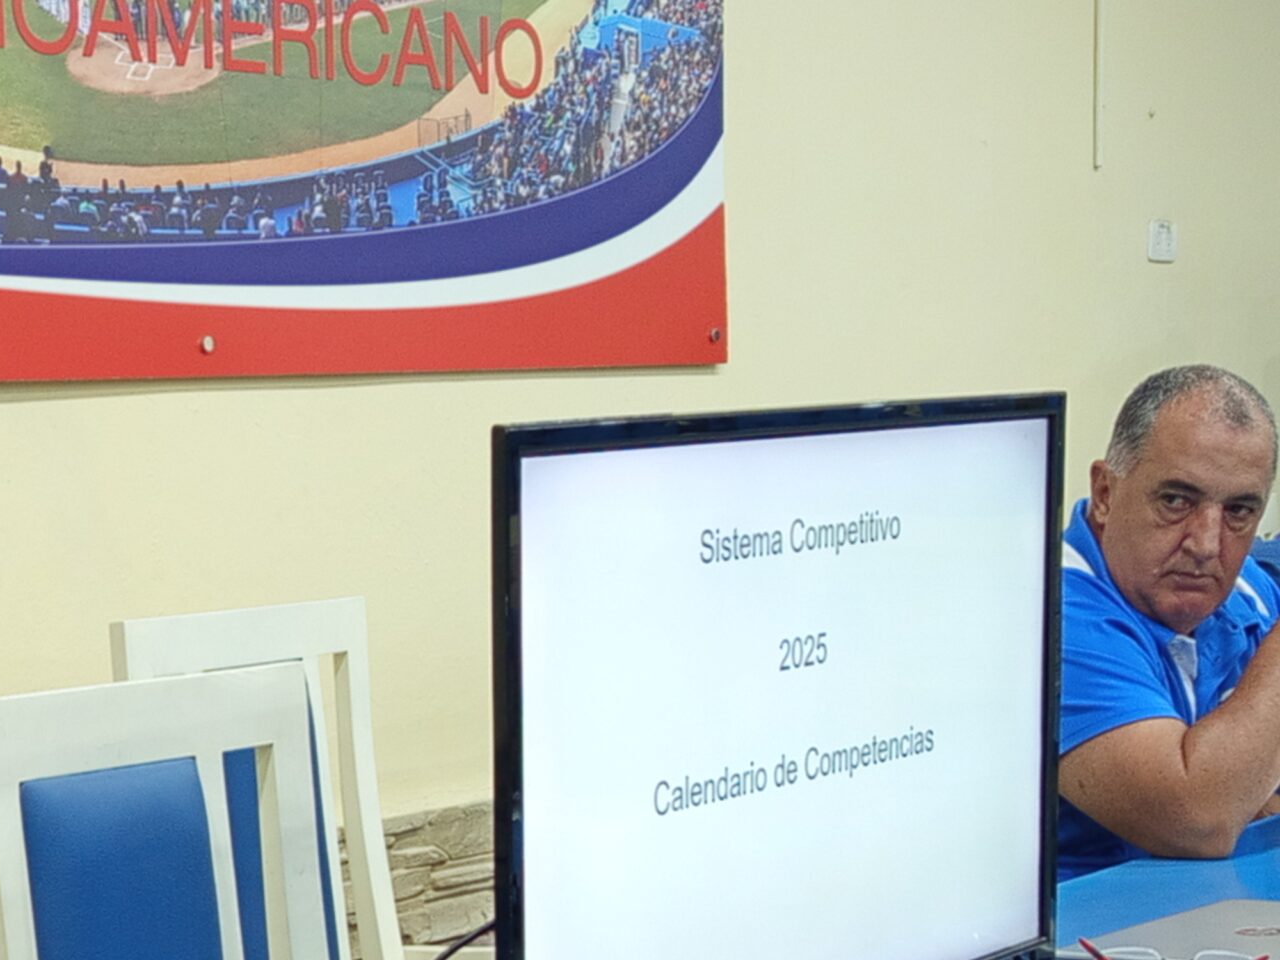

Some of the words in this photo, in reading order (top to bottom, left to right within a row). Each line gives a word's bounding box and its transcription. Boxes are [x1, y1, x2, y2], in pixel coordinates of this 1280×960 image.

[700, 528, 783, 564] Sistema
[790, 510, 901, 555] Competitivo
[779, 632, 828, 671] 2025
[654, 761, 767, 816] Calendario
[774, 754, 798, 788] de
[805, 725, 935, 778] Competencias
